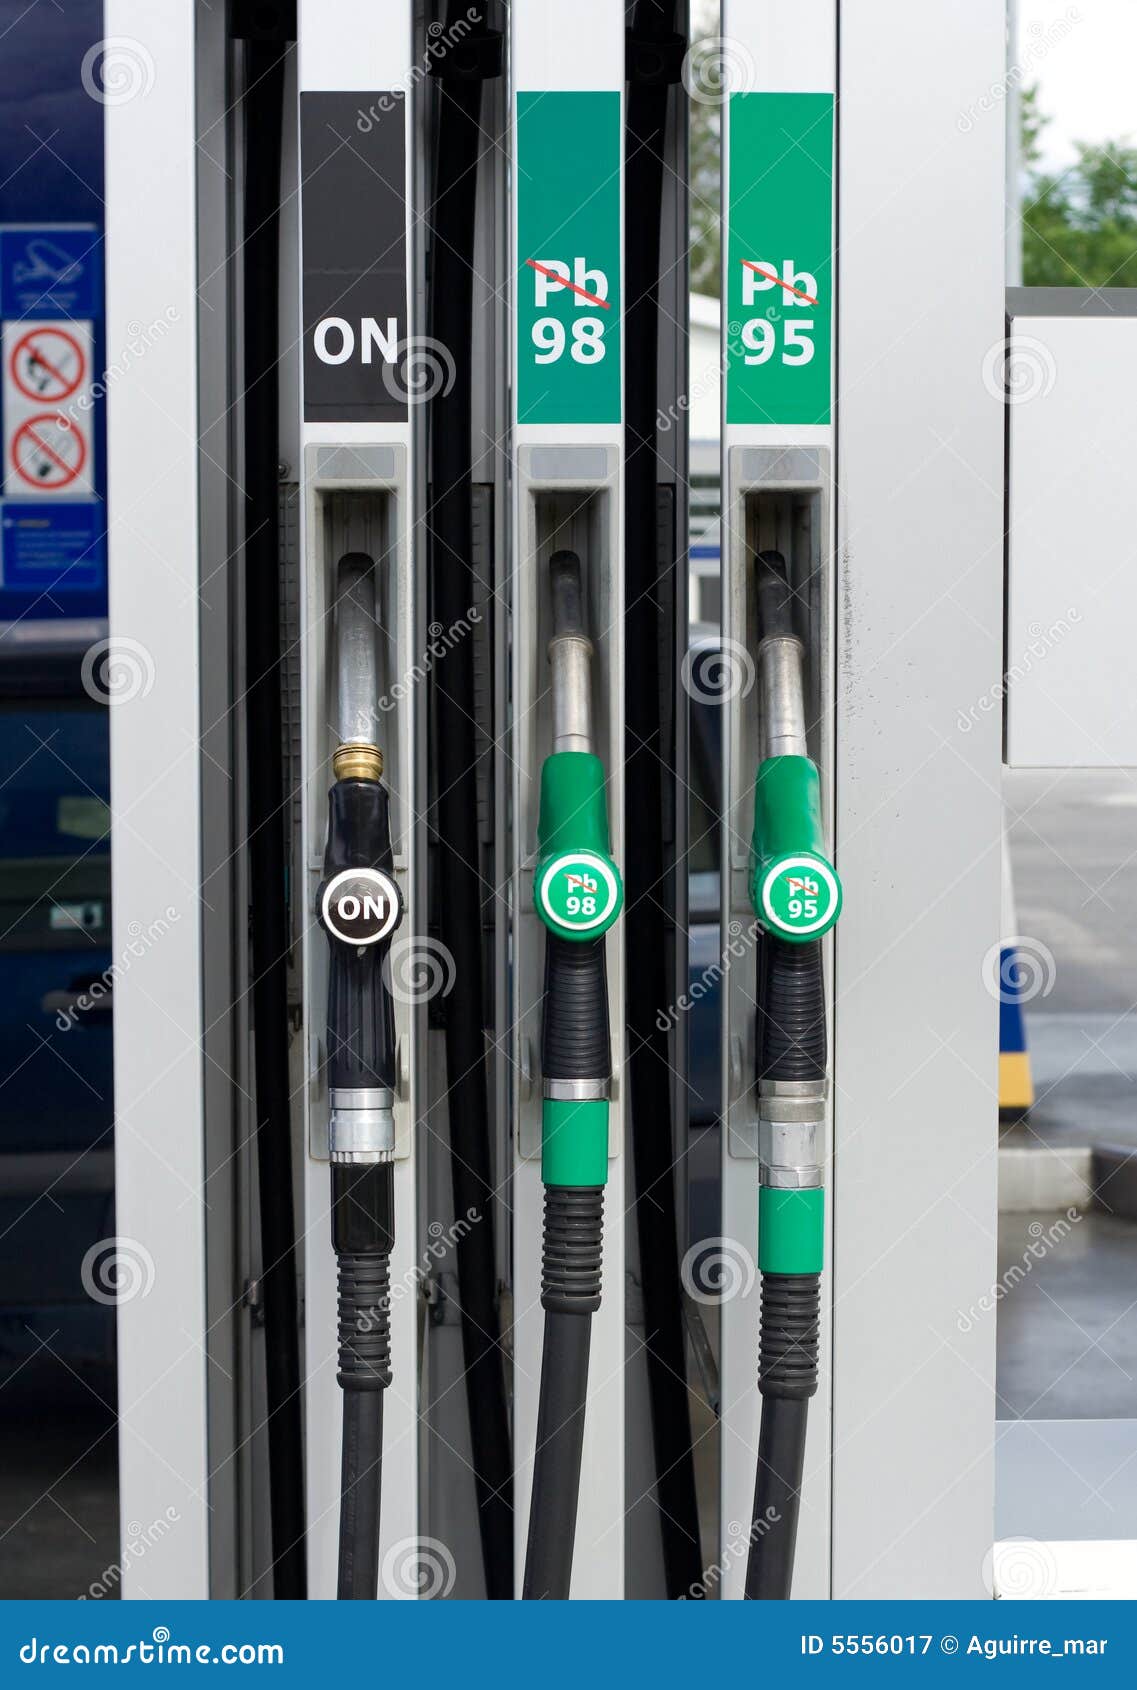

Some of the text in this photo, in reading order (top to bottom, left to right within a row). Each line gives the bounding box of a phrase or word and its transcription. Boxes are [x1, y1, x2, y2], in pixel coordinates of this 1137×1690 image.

[535, 257, 609, 307] Pb
[742, 260, 818, 307] Pb
[313, 317, 398, 364] ON
[531, 317, 606, 365] 98
[741, 318, 815, 366] 95
[567, 873, 598, 894] Pb
[789, 876, 819, 897] Pb
[337, 895, 384, 920] ON
[566, 896, 596, 916] 98
[788, 899, 818, 919] 95
